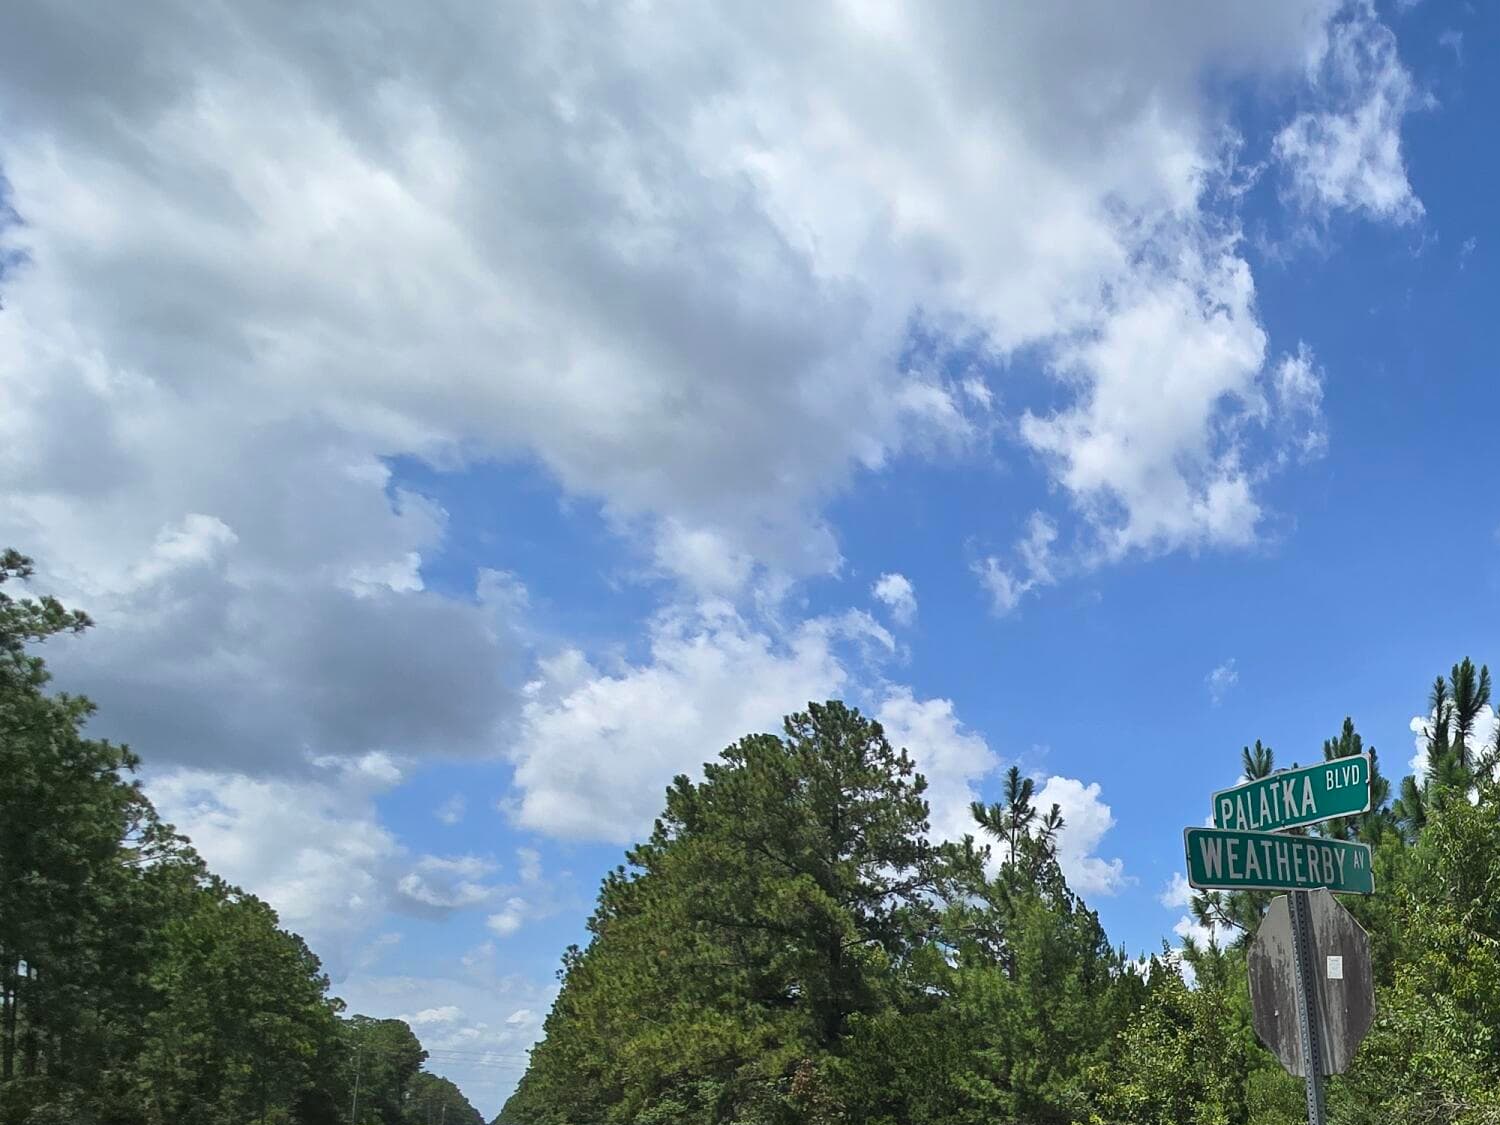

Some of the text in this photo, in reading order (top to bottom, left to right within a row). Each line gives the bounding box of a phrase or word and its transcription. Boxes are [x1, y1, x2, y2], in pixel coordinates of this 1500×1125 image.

[1221, 765, 1360, 830] PALATKA BLVD
[1199, 836, 1346, 885] WEATHERBY
